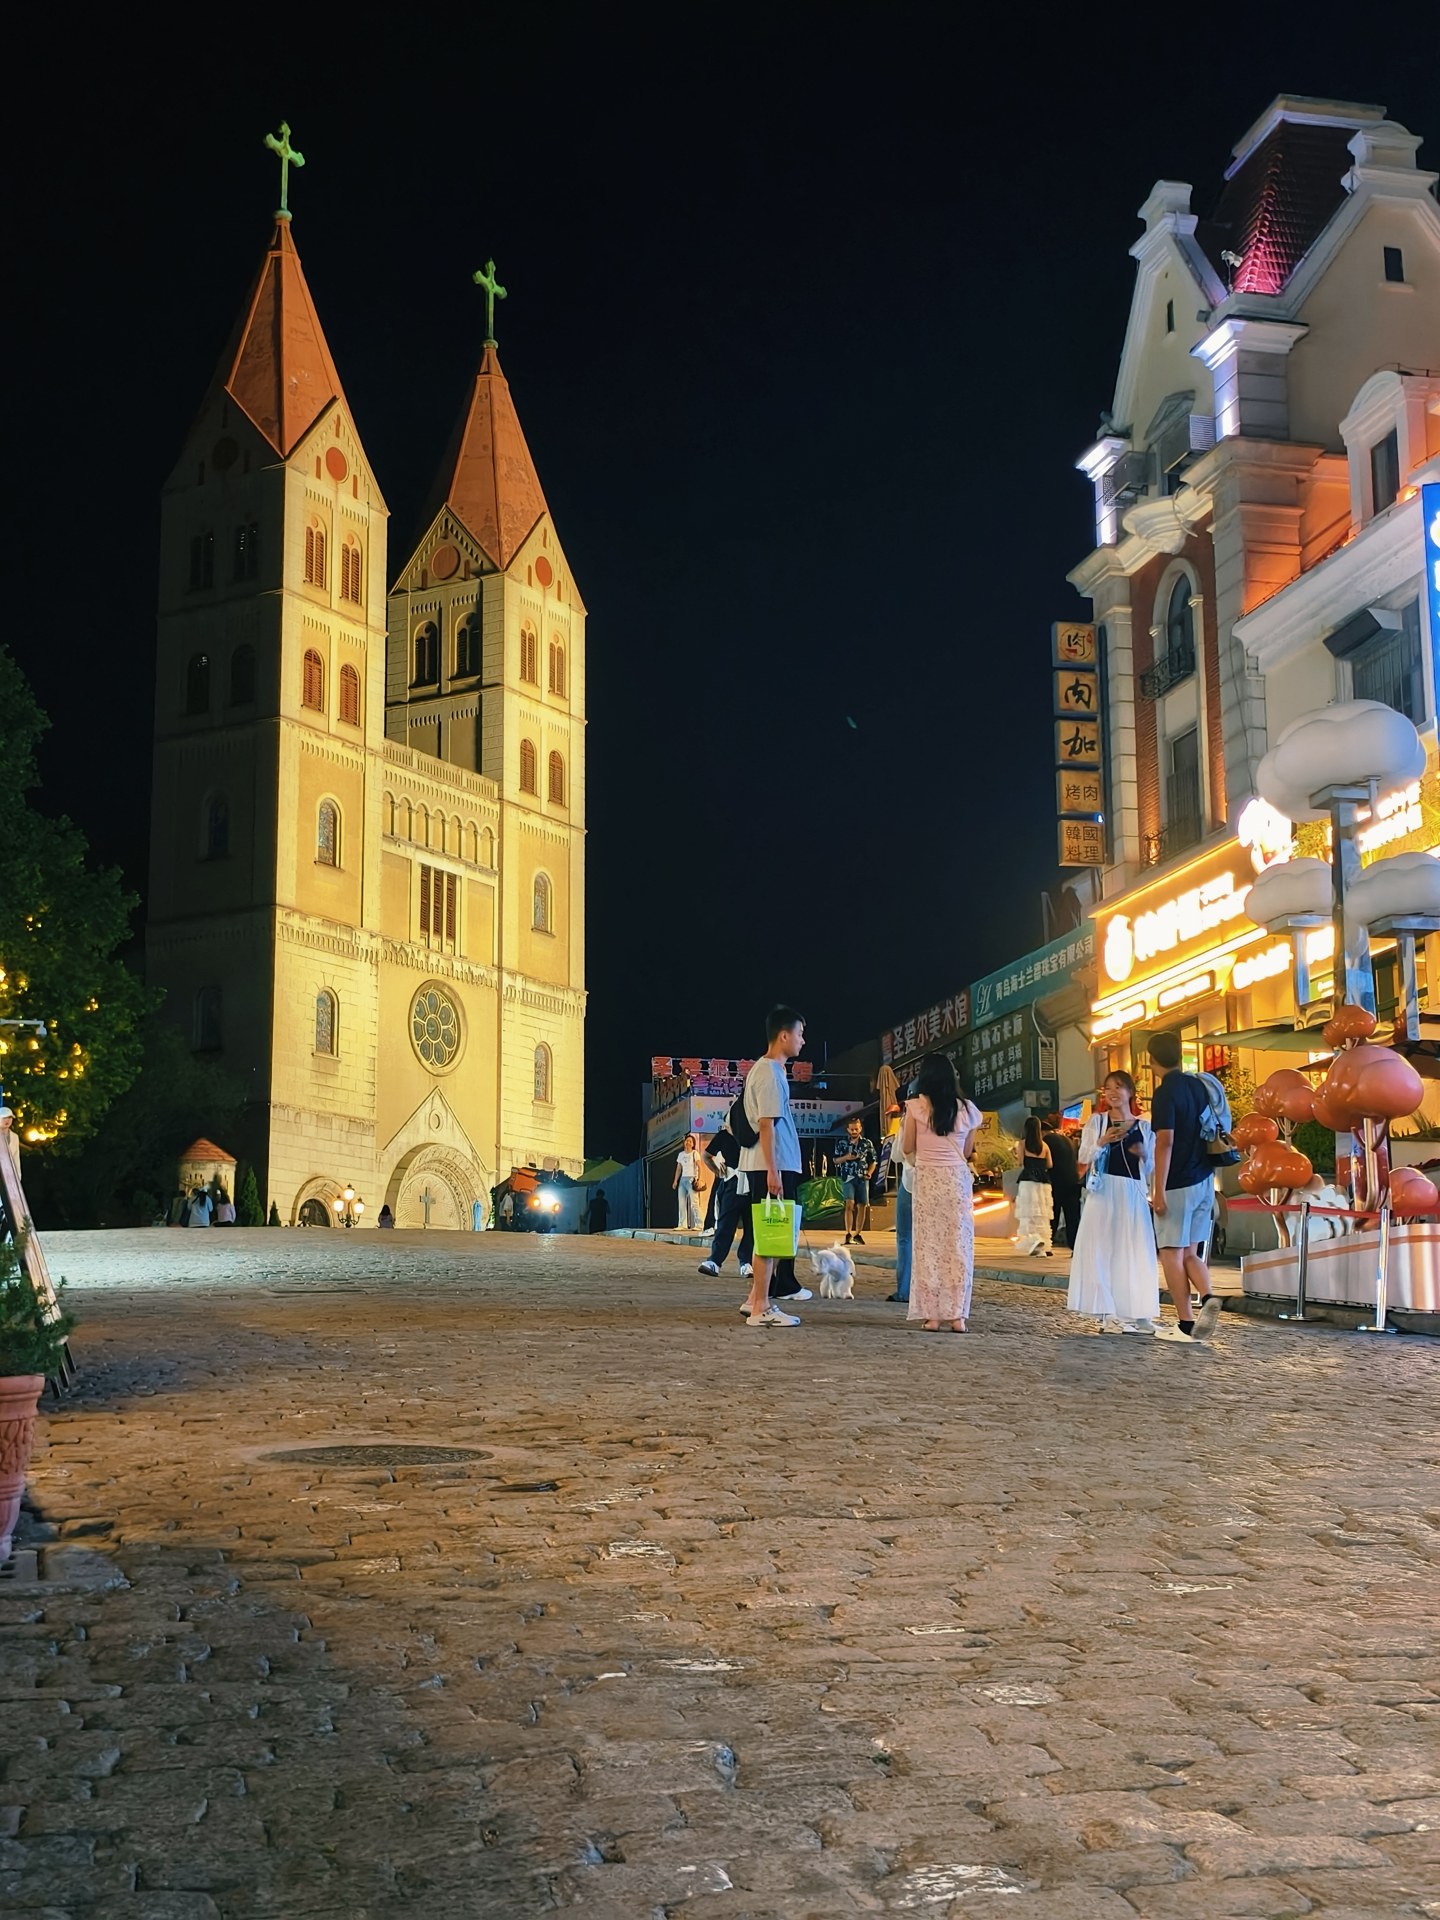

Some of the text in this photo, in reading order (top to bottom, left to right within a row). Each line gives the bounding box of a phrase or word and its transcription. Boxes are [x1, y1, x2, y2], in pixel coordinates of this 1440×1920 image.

[1065, 784, 1098, 801] 烤肉
[1065, 826, 1098, 842] 韓國
[1065, 844, 1098, 861] 料理
[892, 992, 968, 1060] 圣爱尔美术馆
